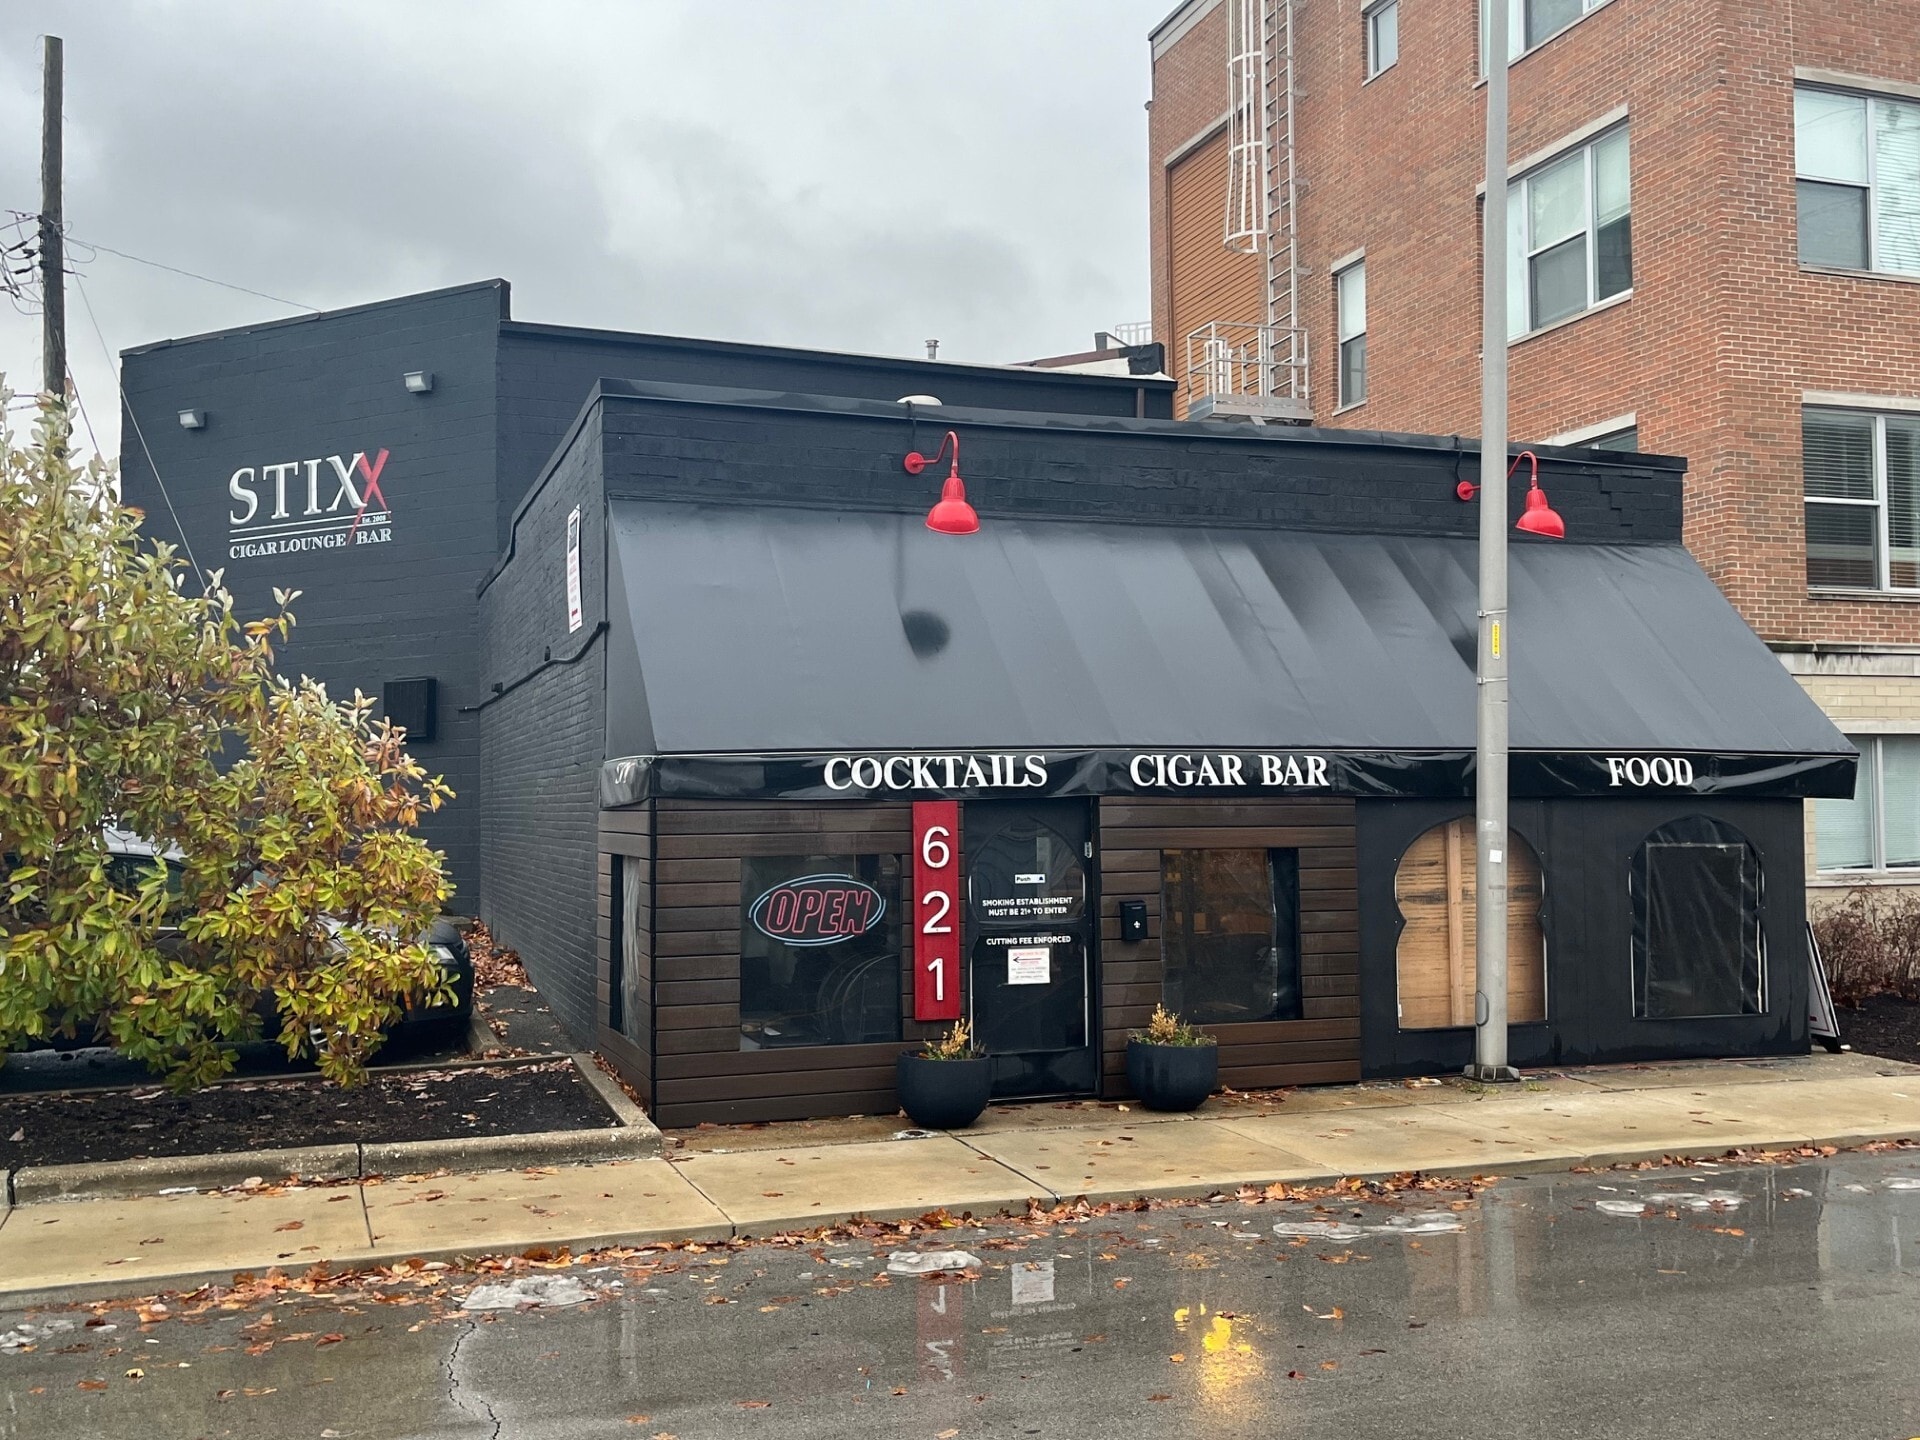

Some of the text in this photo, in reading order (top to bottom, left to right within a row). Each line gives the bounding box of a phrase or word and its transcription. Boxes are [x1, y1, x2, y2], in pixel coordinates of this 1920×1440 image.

[229, 448, 391, 525] STIXX
[229, 527, 392, 559] CIGAR LOUNGE BAR
[824, 754, 1048, 790] COCKTAILS
[1130, 754, 1331, 787] CIGAR BAR
[1605, 757, 1693, 787] FOOD
[767, 889, 871, 934] OPEN
[982, 897, 1073, 907] SMOKING ESTABLISHMENT
[988, 908, 1008, 916] MUST
[986, 937, 1018, 946] CUTTING
[1034, 935, 1072, 943] ENFORCED
